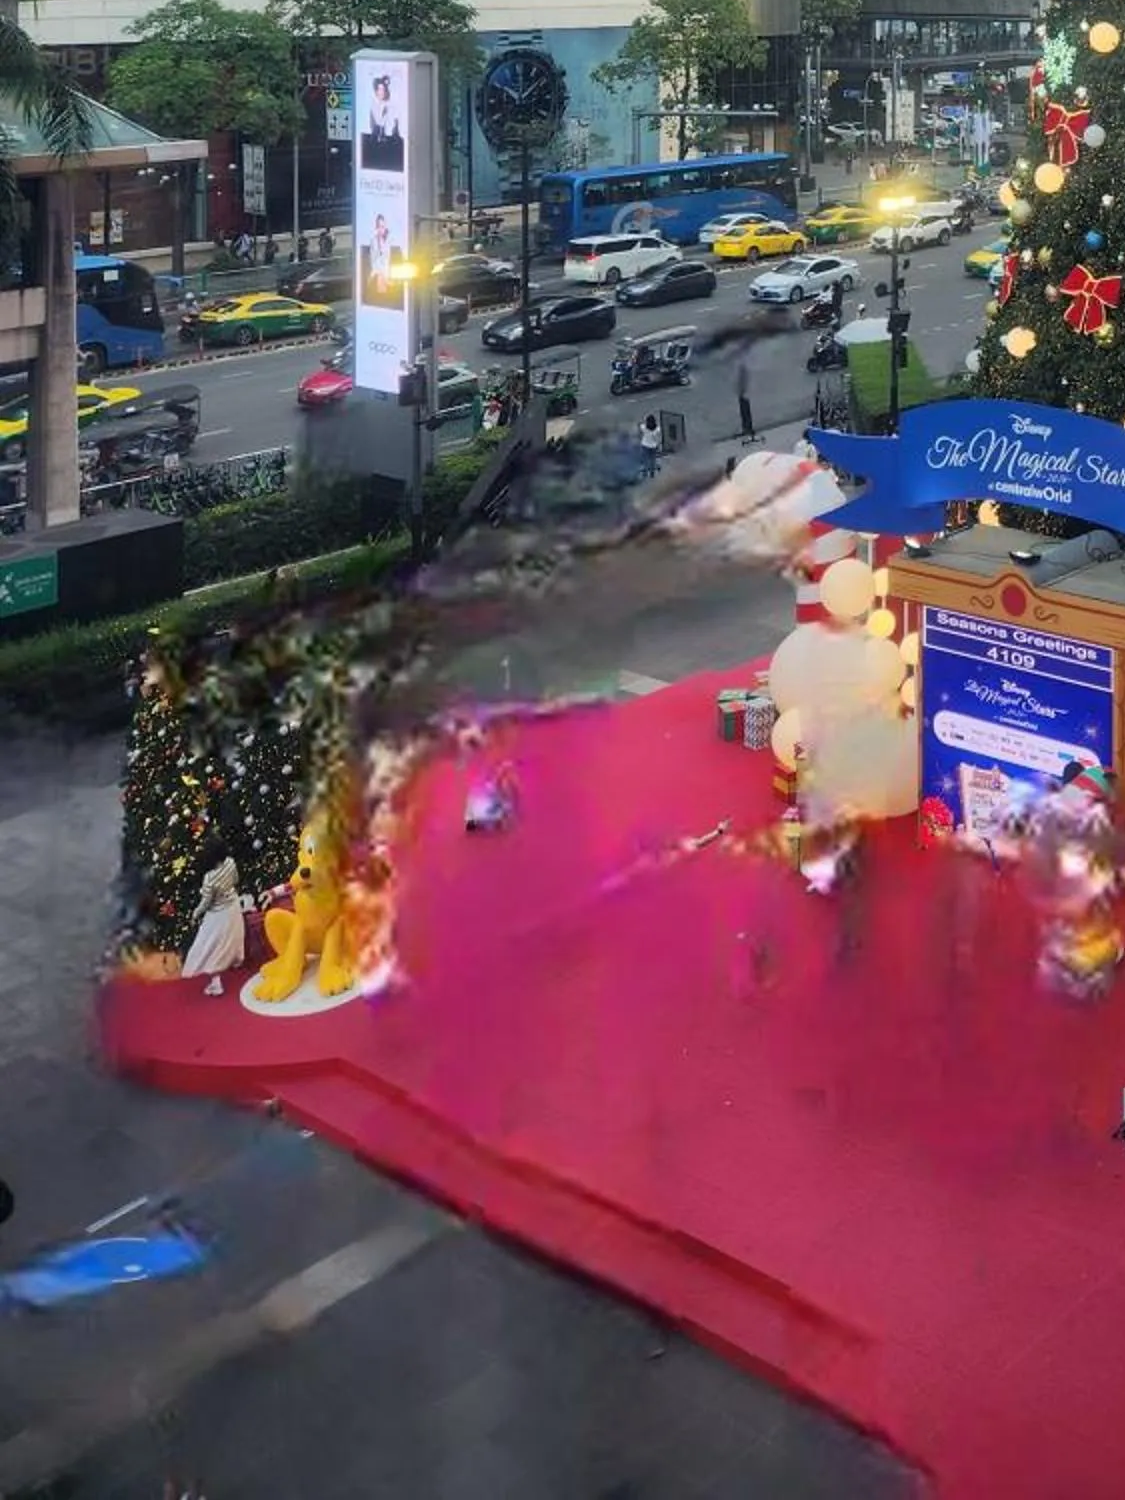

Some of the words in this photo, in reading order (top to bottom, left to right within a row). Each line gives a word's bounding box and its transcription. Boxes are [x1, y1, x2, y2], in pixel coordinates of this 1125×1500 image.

[1008, 413, 1053, 441] Disney
[926, 436, 969, 469] The
[968, 428, 1076, 481] Magical
[936, 612, 1009, 639] Seasons
[1013, 631, 1098, 660] Greetings
[986, 646, 1036, 669] 4109
